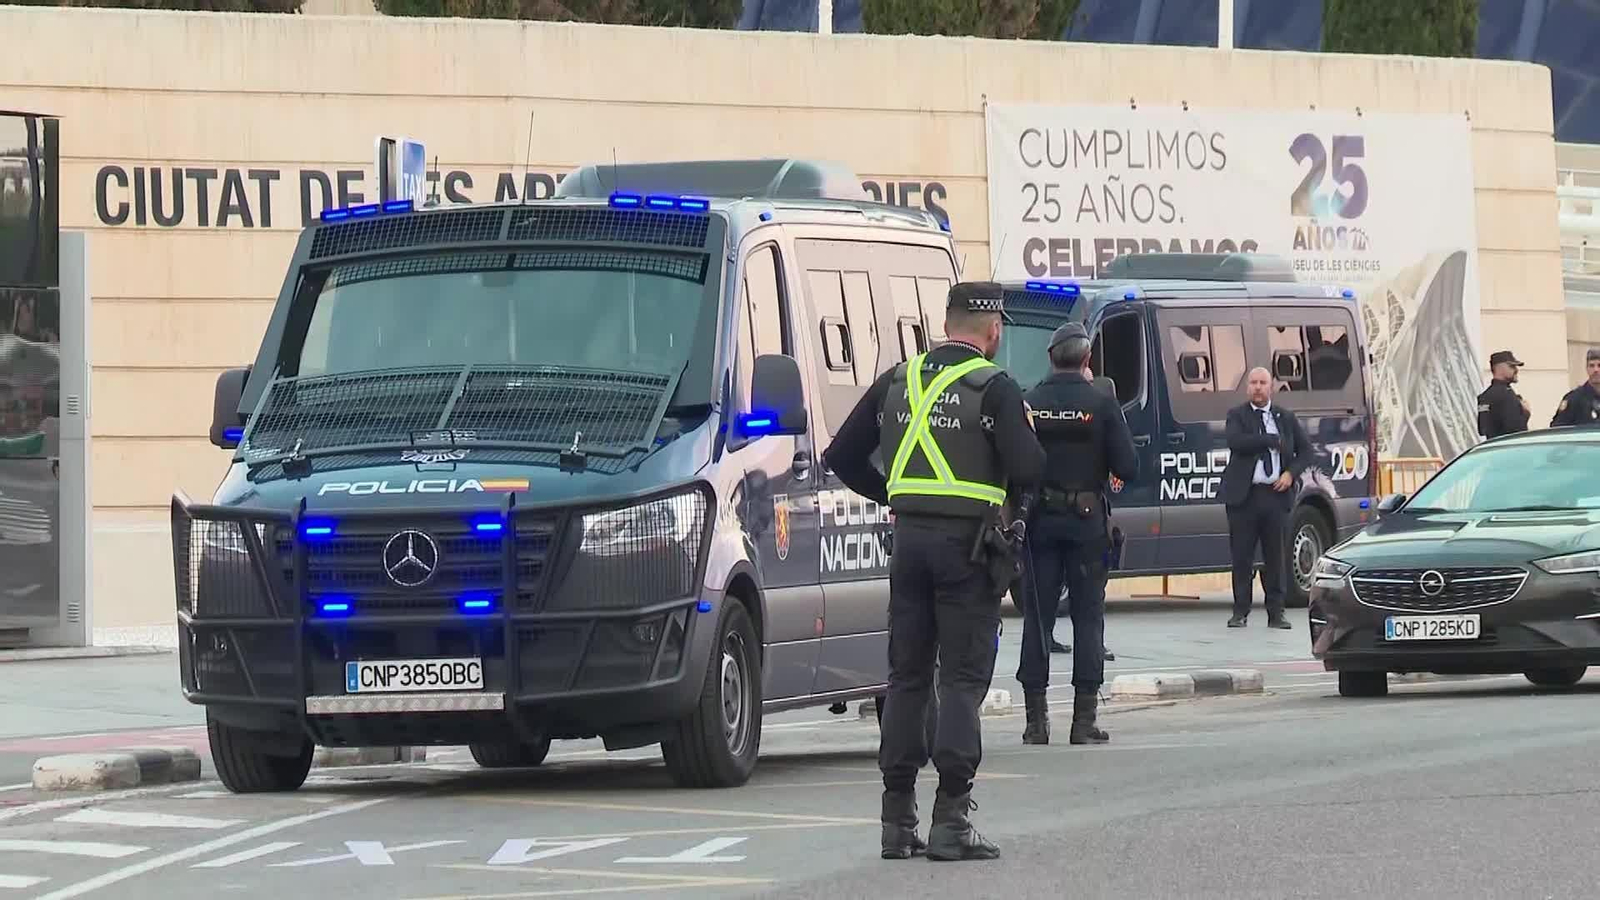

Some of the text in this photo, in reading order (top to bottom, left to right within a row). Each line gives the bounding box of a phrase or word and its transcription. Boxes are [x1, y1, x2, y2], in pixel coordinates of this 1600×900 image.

[1018, 127, 1227, 170] CUMPLIMOS
[1289, 132, 1368, 219] 25
[95, 165, 280, 228] CIUTAT
[1021, 174, 1185, 223] 25 AÑOS.
[1313, 259, 1324, 271] DE
[1326, 259, 1341, 271] LES
[897, 411, 961, 429] VANCIA
[1031, 410, 1085, 420] POLICIA
[1331, 446, 1369, 480] 200
[318, 478, 485, 496] POLICIA
[1160, 477, 1221, 501] NACIO
[820, 531, 891, 573] NACION
[1394, 620, 1475, 637] CNP1285KD
[360, 662, 480, 687] CNP3850BC
